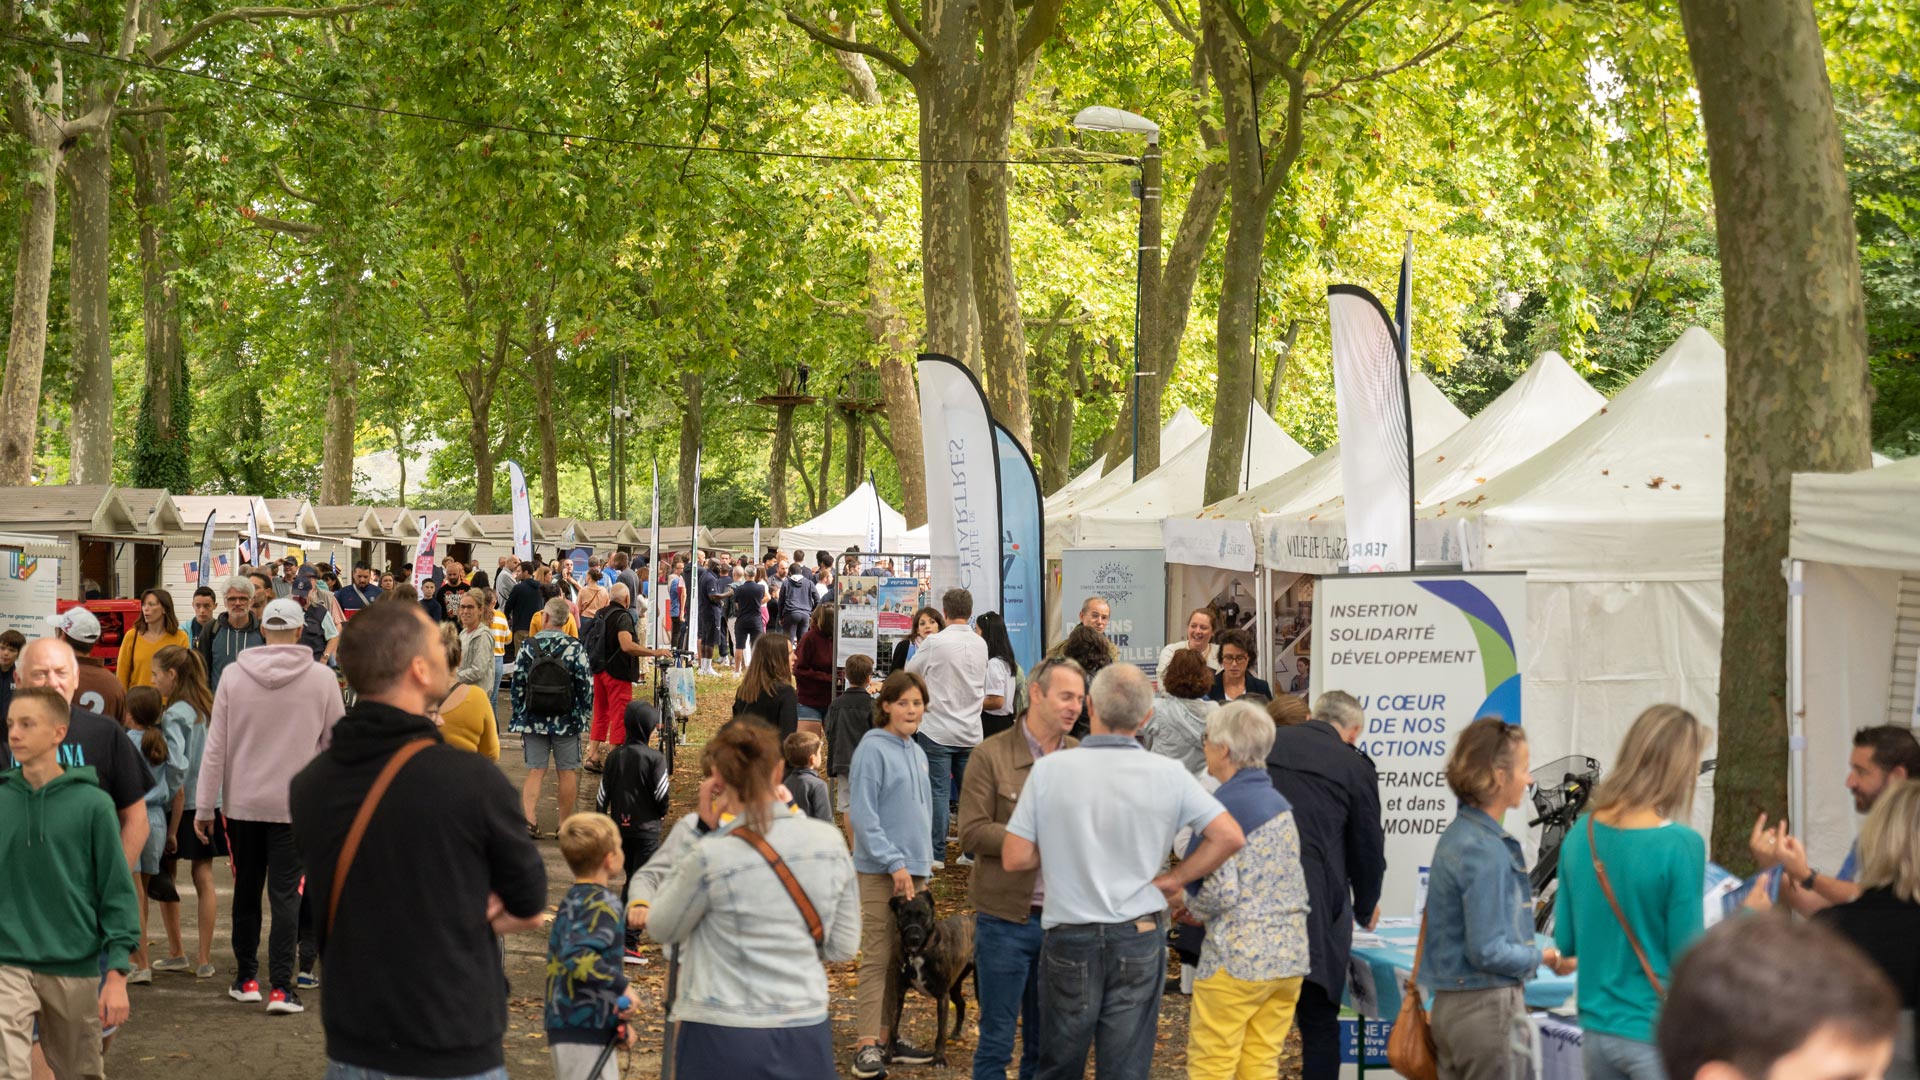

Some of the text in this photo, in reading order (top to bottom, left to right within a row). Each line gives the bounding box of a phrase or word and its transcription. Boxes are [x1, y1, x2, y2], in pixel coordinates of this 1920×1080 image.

[1330, 604, 1418, 618] INSERTION
[1329, 625, 1436, 641] SOLIDARITÉ
[1331, 649, 1476, 665] DÉVELOPPEMENT
[1377, 694, 1446, 711] CŒUR
[1369, 717, 1446, 734] DE NOS
[1358, 740, 1446, 757] ACTIONS
[1376, 772, 1446, 787] FRANCE
[1386, 795, 1446, 811] et dans
[1383, 819, 1447, 834] MONDE
